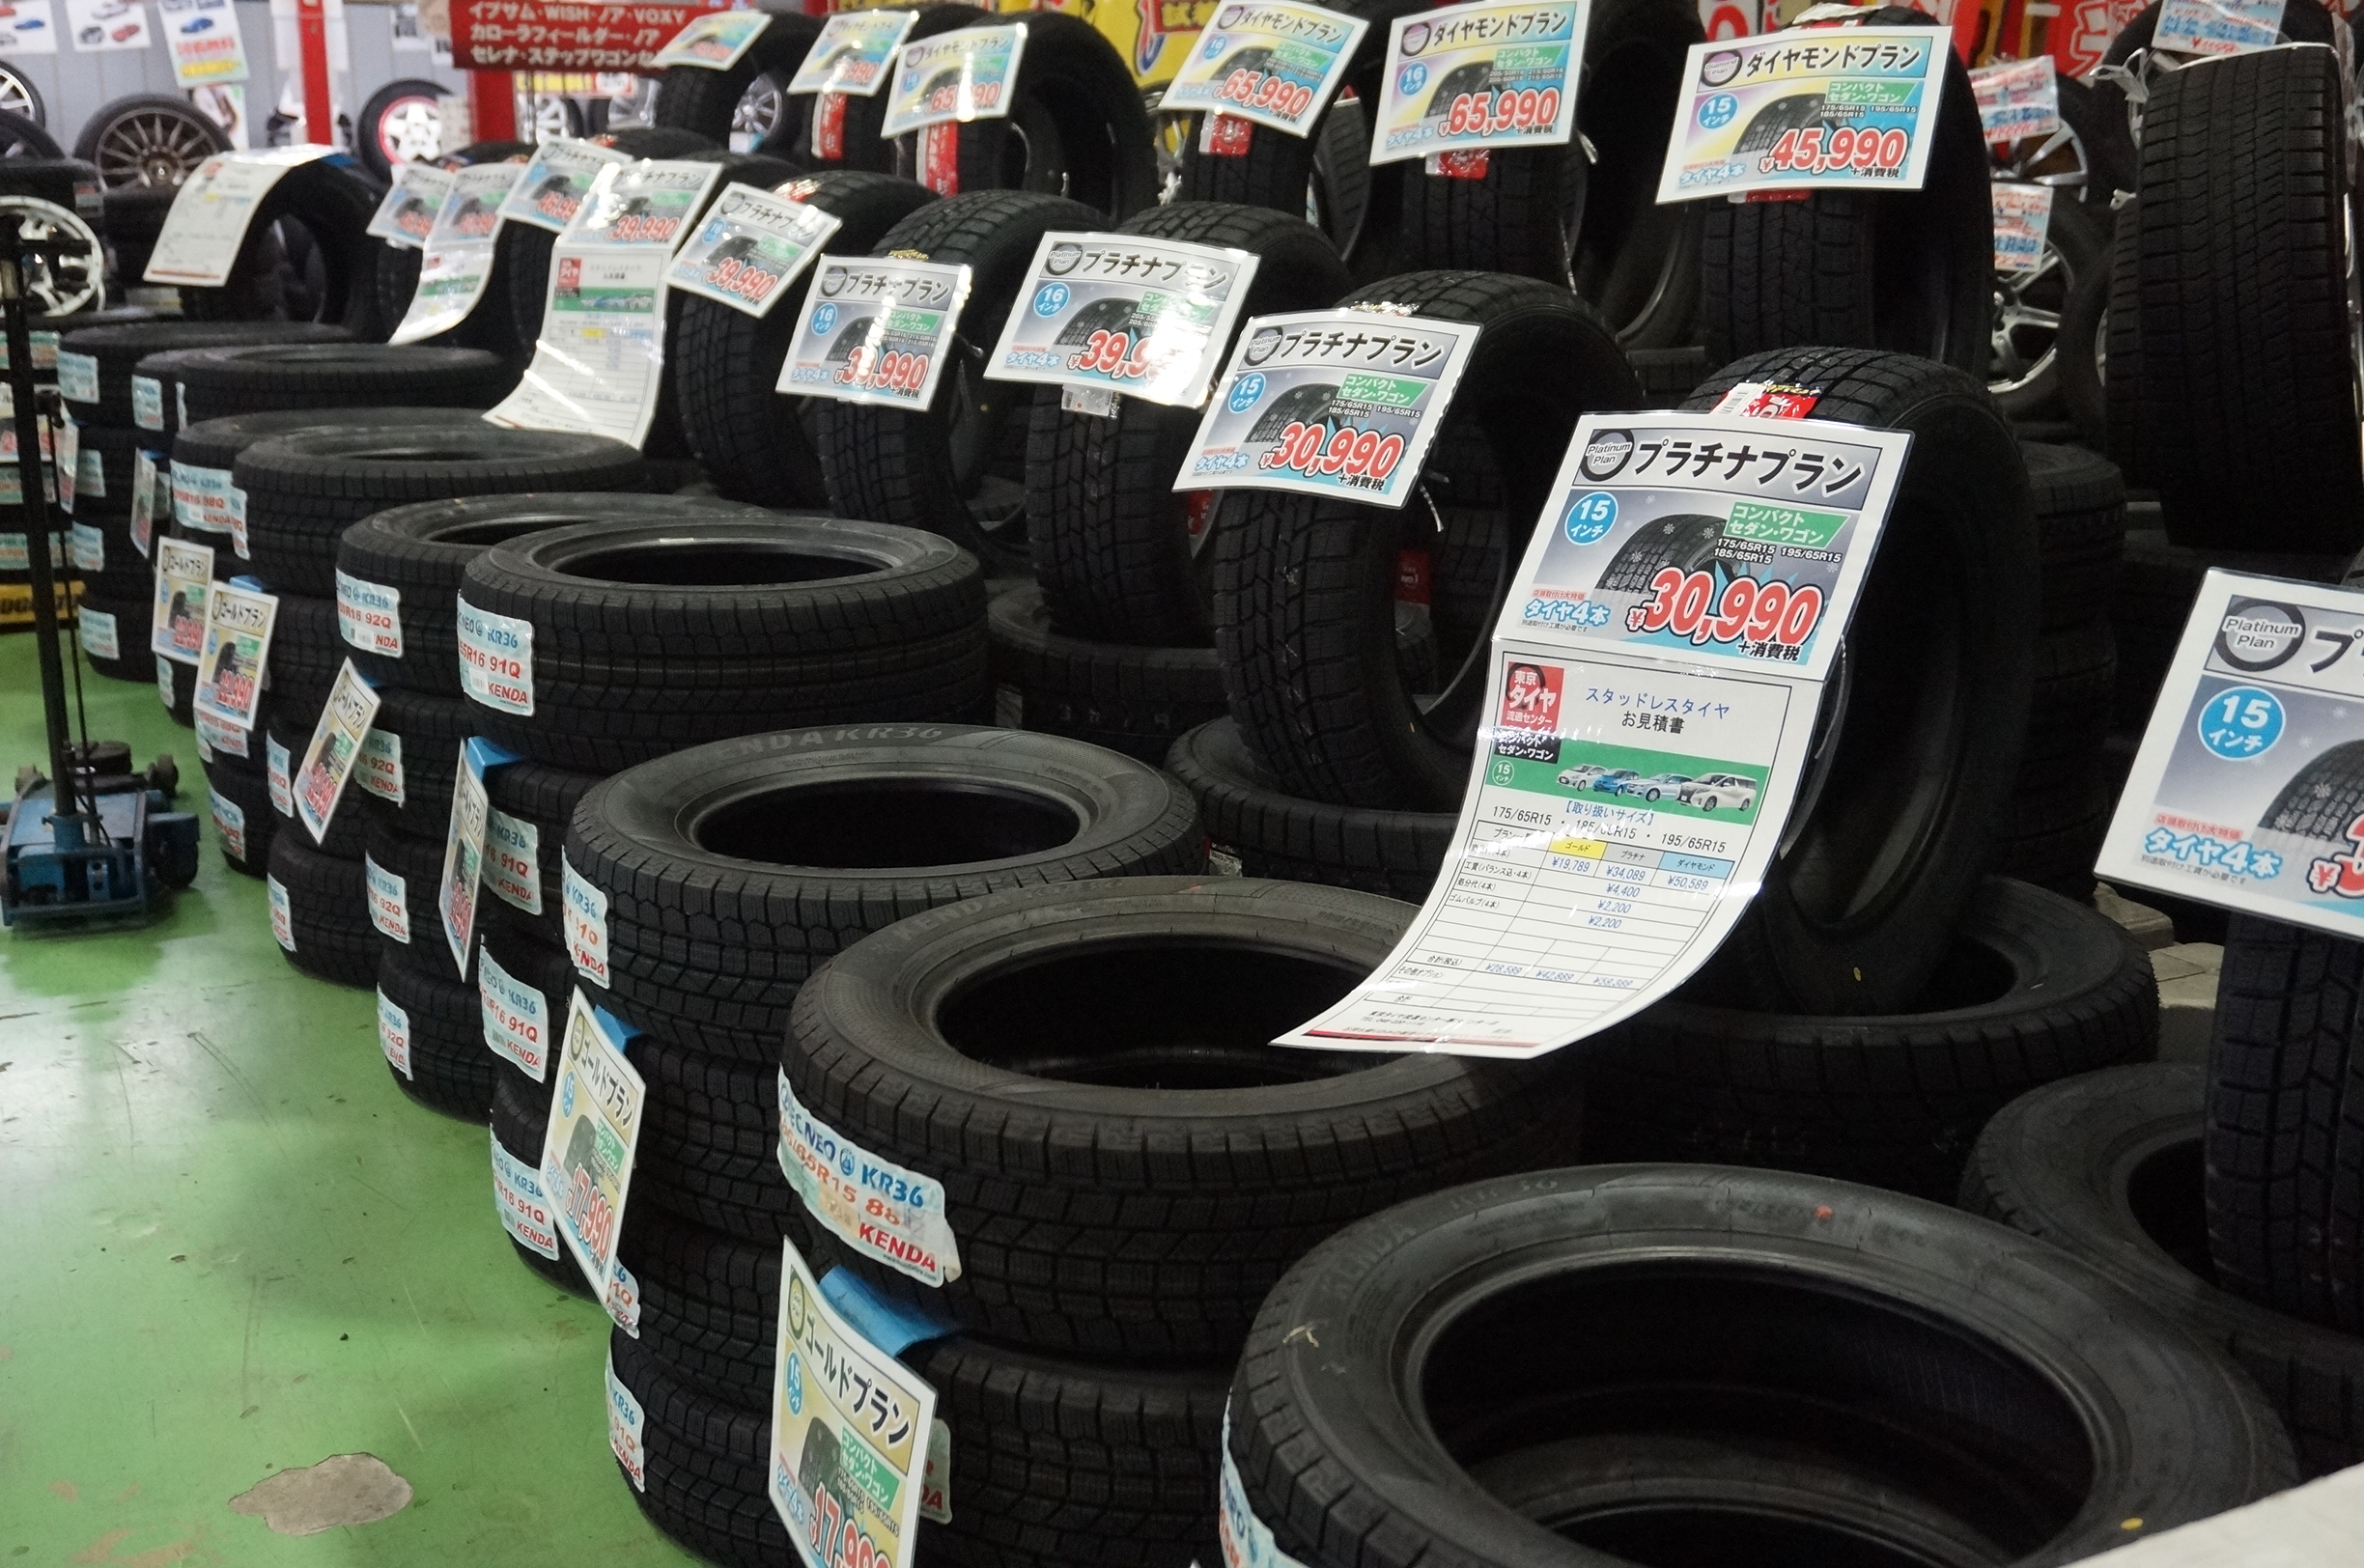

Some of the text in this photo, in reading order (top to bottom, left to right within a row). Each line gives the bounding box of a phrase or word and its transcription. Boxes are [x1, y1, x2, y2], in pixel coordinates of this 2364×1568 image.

[1434, 11, 1567, 46] ダイヤモンドプラン
[1746, 43, 1921, 78] ダイヤモンドプラン
[1404, 66, 1423, 83] 16
[1828, 91, 1901, 103] セダン・ワゴン
[1830, 81, 1885, 94] コンパクト
[1439, 87, 1562, 137] ¥65,990
[1707, 97, 1731, 115] 15
[1702, 113, 1731, 126] インチ
[1759, 127, 1909, 174] ¥45,990
[1850, 166, 1900, 179] +消費税
[1049, 249, 1082, 260] Platinum
[1043, 287, 1066, 303] 16
[1251, 334, 1280, 349] Platinum
[1252, 345, 1269, 354] Plan
[1280, 329, 1443, 367] プラチナプラン
[1239, 378, 1260, 395] 15
[1346, 375, 1397, 391] コンパクト
[1230, 393, 1254, 409] インチ
[1340, 385, 1410, 405] セダン・ワゴン
[1328, 406, 1370, 418] 185/65R15
[1332, 399, 1421, 419] 175/65R15 195/65R15
[1259, 422, 1405, 478] ¥30,990
[1587, 441, 1631, 458] Platinum
[1592, 454, 1617, 465] Plan
[1634, 438, 1862, 496] プラチナプラン
[1337, 474, 1387, 491] +消費税
[1579, 499, 1611, 522] 15
[1732, 505, 1806, 527] コンパクト
[1570, 523, 1604, 538] インチ
[1729, 519, 1825, 546] セダン・ワゴン
[1713, 546, 1773, 565] 185/65R15
[1716, 537, 1842, 564] 175/65R15 195/65R15
[1524, 600, 1612, 627] タイヤ4本
[1628, 569, 1823, 645] ¥30,990
[365, 612, 391, 630] 92Q
[2226, 616, 2301, 637] Platinum
[487, 628, 519, 649] KR36
[2237, 634, 2275, 650] Plan
[1737, 640, 1802, 661] +消費税
[2309, 630, 2364, 674] プ
[490, 656, 521, 679] 91Q
[1513, 671, 1537, 686] 東京
[488, 682, 528, 705] KENDA
[1508, 685, 1558, 713] タイヤ
[1586, 686, 1731, 720] スタッドレスタイヤ
[1621, 710, 1686, 735] お見積書
[2222, 694, 2271, 730] 15
[2208, 728, 2264, 752] インチ
[1498, 743, 1555, 761] セダン・ワゴン
[370, 757, 395, 775] 92Q
[1497, 764, 1511, 774] 15
[1492, 805, 1727, 854] 175/65R15 195/65R15
[1564, 841, 1590, 853] ゴールド
[1620, 850, 1646, 861] プラチナ
[2145, 826, 2283, 879] タイヤ4本
[500, 856, 529, 878] 91Q
[1552, 856, 1709, 891] ¥19,789 ¥34,089 ¥50,589
[1676, 858, 1717, 872] ダイヤモンド
[497, 878, 533, 902] KENDA
[1606, 883, 1641, 898] ¥4,400
[379, 897, 402, 917] 92Q
[1596, 900, 1632, 914] ¥2,200
[1588, 915, 1622, 930] ¥2,200
[508, 987, 537, 1016] KR36
[508, 1015, 538, 1044] 91Q
[506, 1040, 542, 1068] KENDA
[804, 1121, 924, 1208] NEO KR36
[517, 1198, 546, 1226] 91Q
[516, 1219, 554, 1250] KENDA
[859, 1221, 937, 1273] KENDA
[789, 1358, 802, 1389] 15
[804, 1312, 911, 1446] ゴールドプラン
